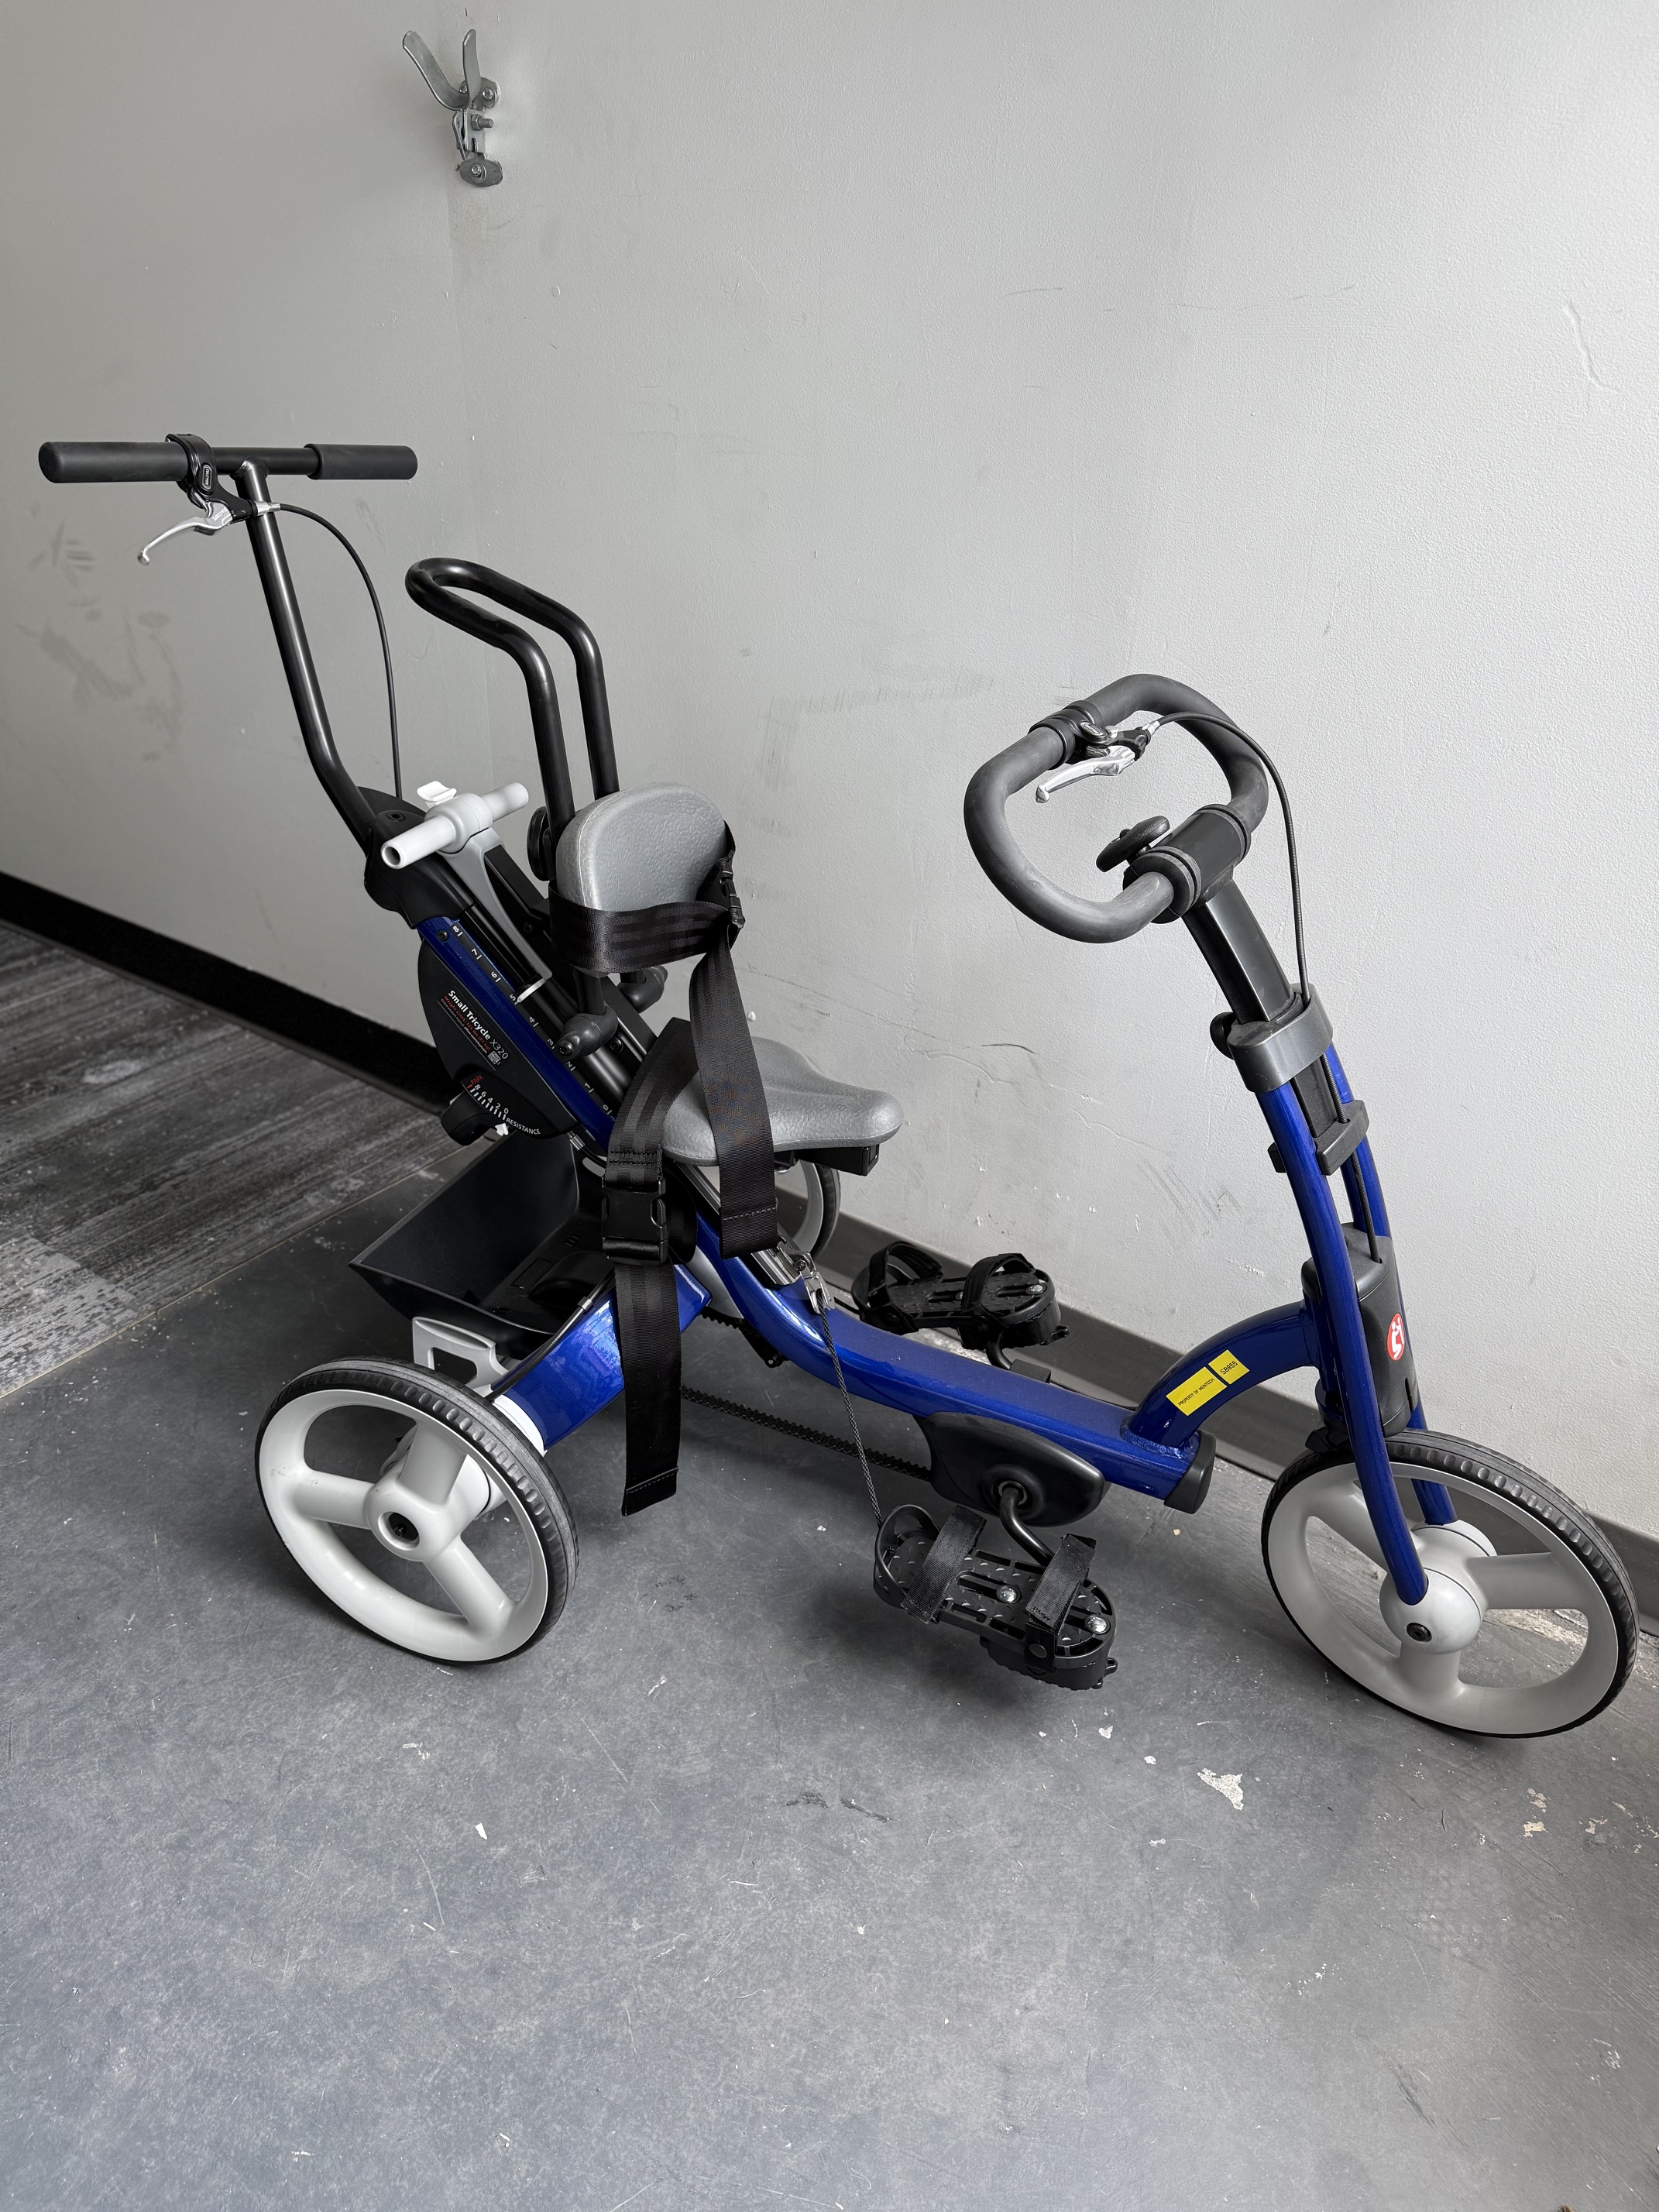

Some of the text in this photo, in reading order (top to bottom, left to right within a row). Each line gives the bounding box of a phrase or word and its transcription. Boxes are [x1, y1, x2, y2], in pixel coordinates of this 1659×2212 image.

[448, 990, 469, 1012] Small
[466, 1011, 491, 1039] Tricycle
[489, 1039, 509, 1060] X320
[470, 1074, 484, 1085] PARK
[506, 1117, 541, 1135] RESISTANCE
[1220, 1360, 1238, 1375] SB855
[1177, 1393, 1194, 1407] PROPERTY
[1199, 1378, 1215, 1391] MONTECH
